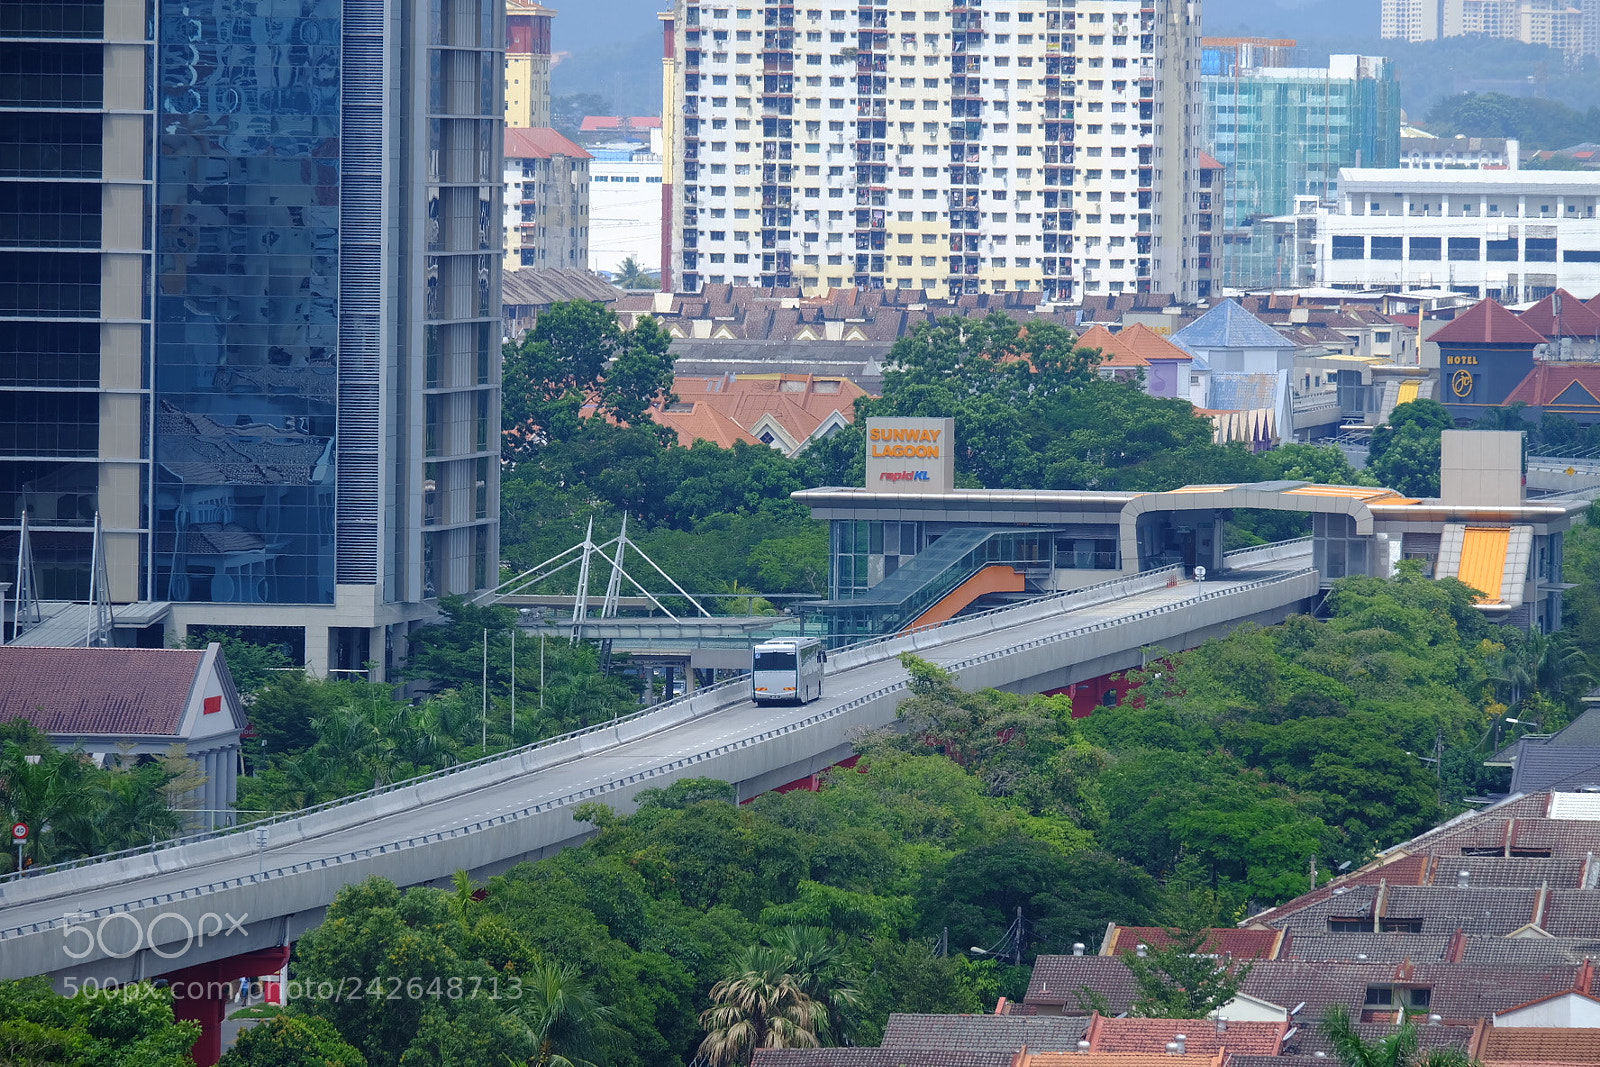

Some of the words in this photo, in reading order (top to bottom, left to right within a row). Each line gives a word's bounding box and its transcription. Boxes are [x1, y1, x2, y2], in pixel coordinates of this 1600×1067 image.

[1447, 356, 1478, 365] HOTEL
[870, 428, 941, 442] SUNWAY
[872, 445, 939, 458] LAGOON
[880, 471, 930, 482] rapidKL
